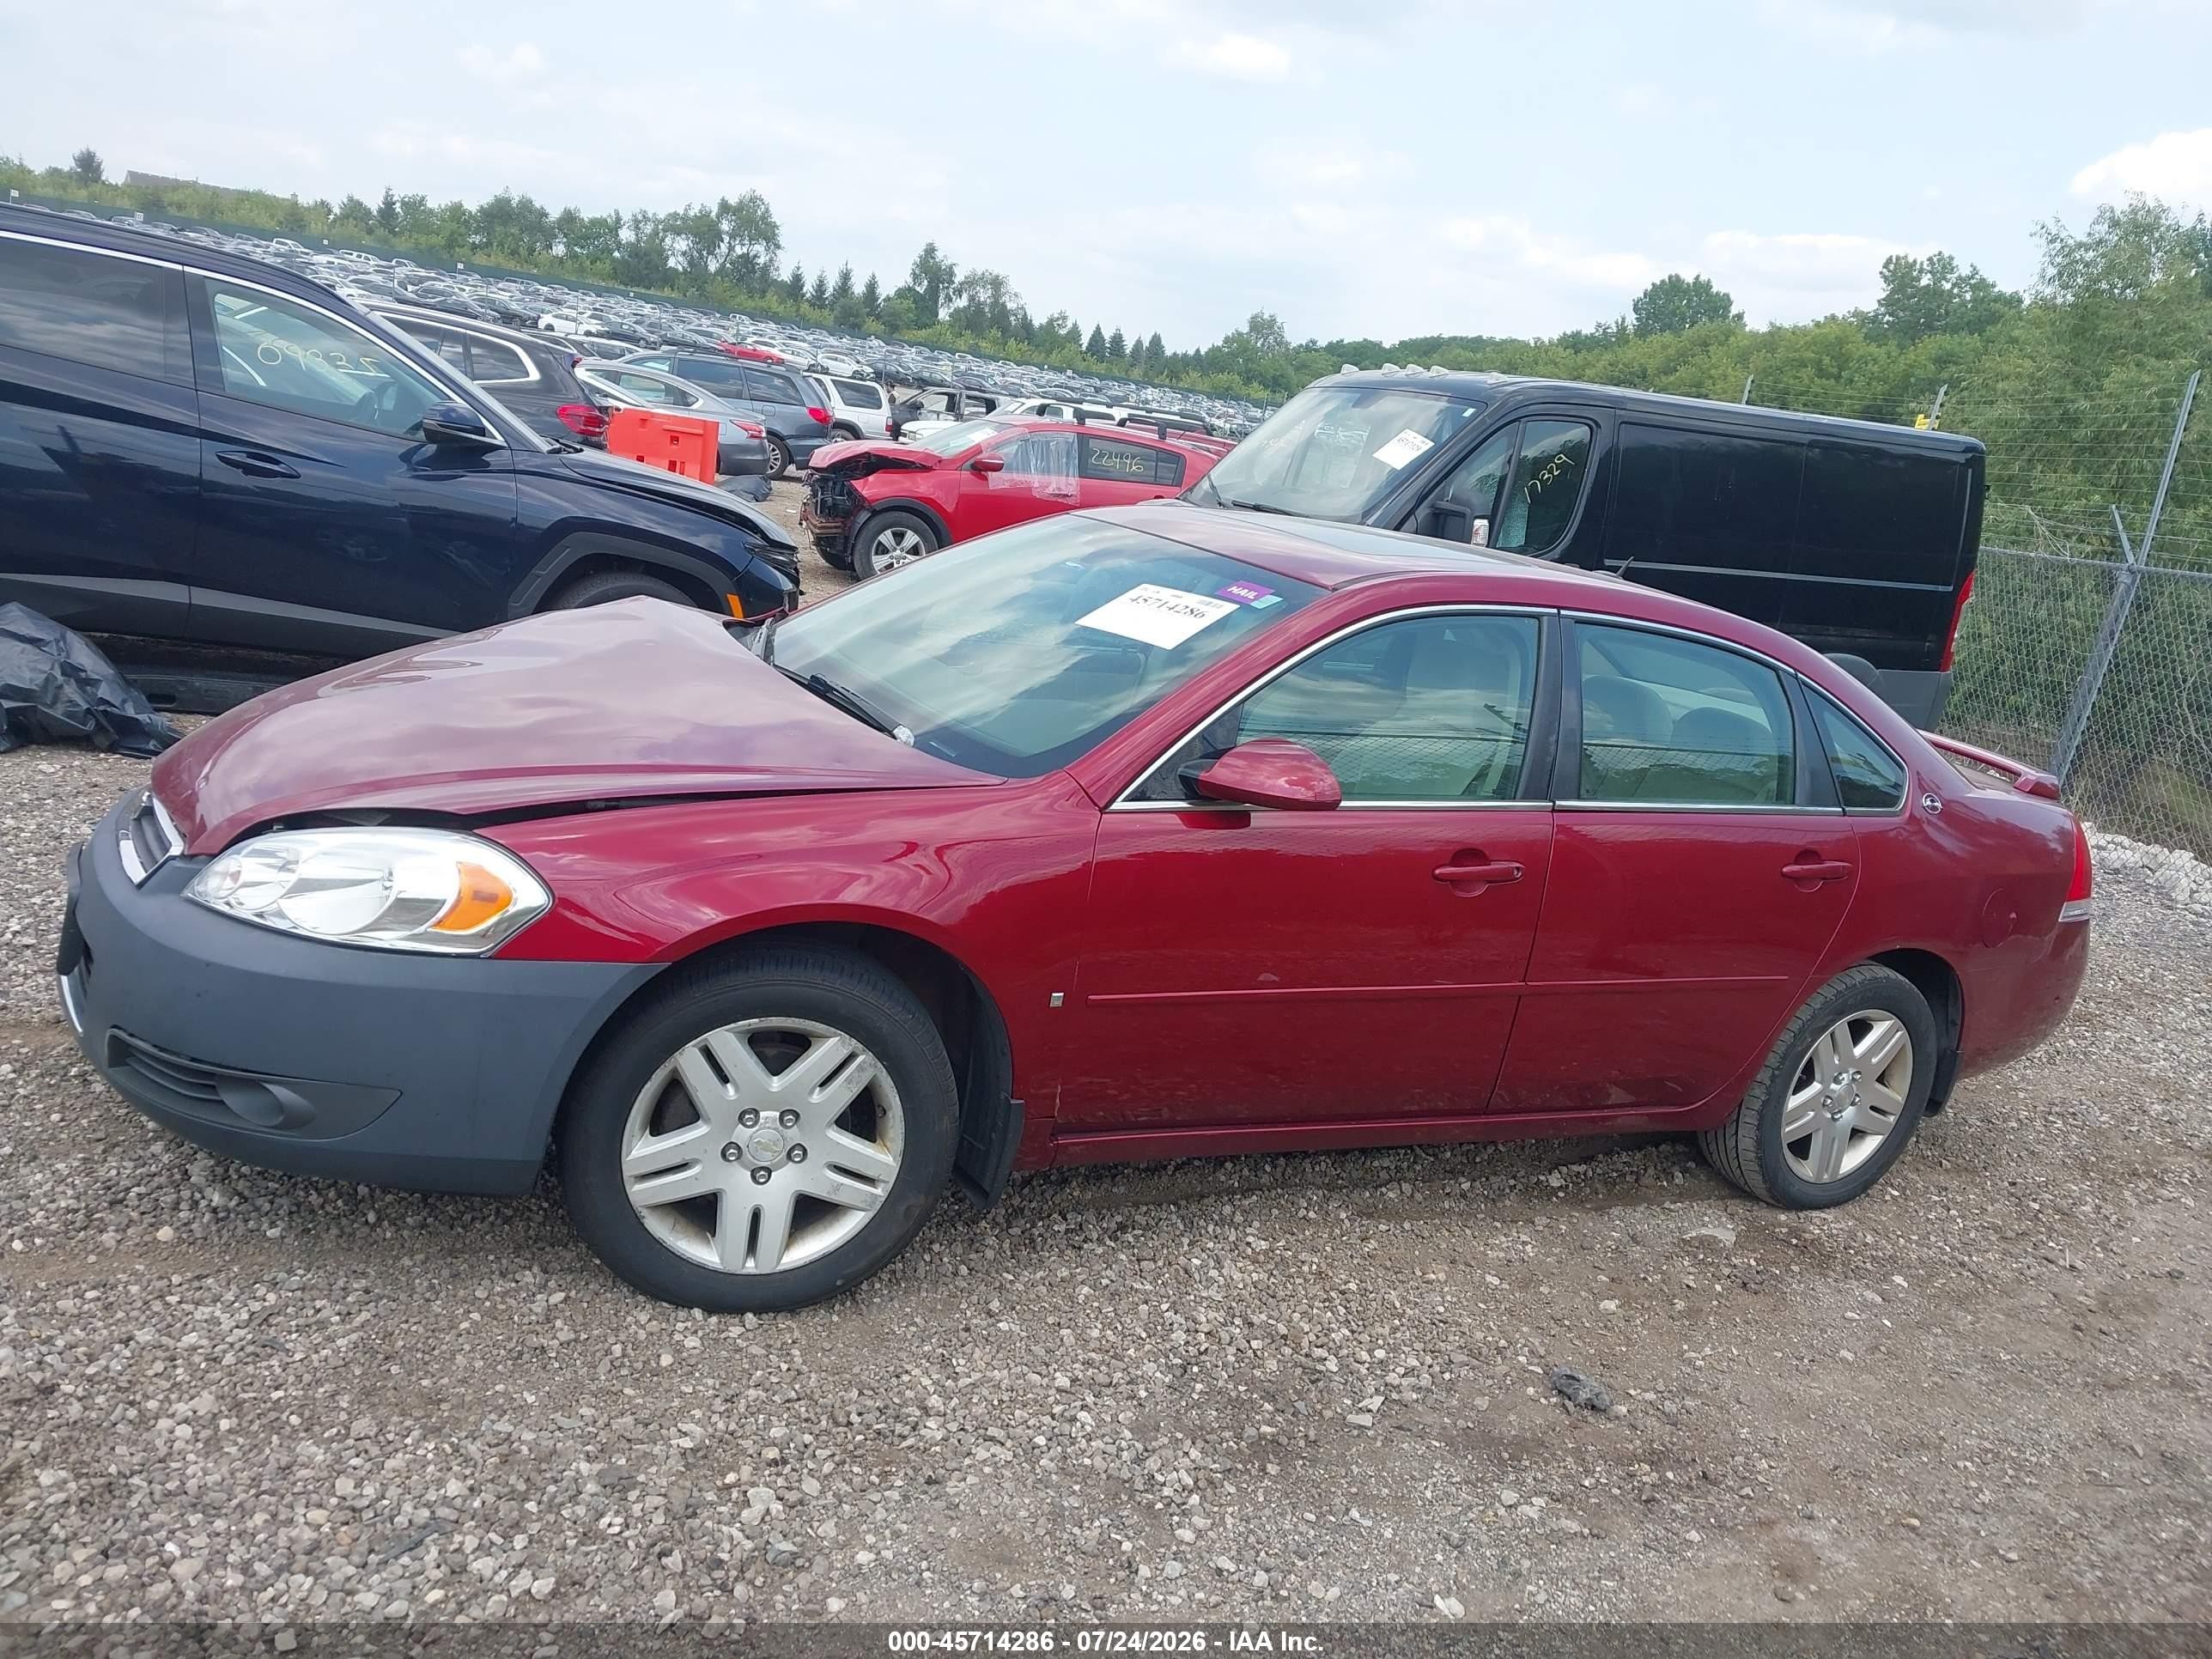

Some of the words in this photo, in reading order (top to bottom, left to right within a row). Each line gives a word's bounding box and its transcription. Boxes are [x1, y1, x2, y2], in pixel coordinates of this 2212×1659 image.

[1091, 447, 1144, 472] 22496
[1524, 453, 1575, 504] 17329
[1226, 586, 1259, 599] HAIL
[1128, 594, 1206, 620] 45714286
